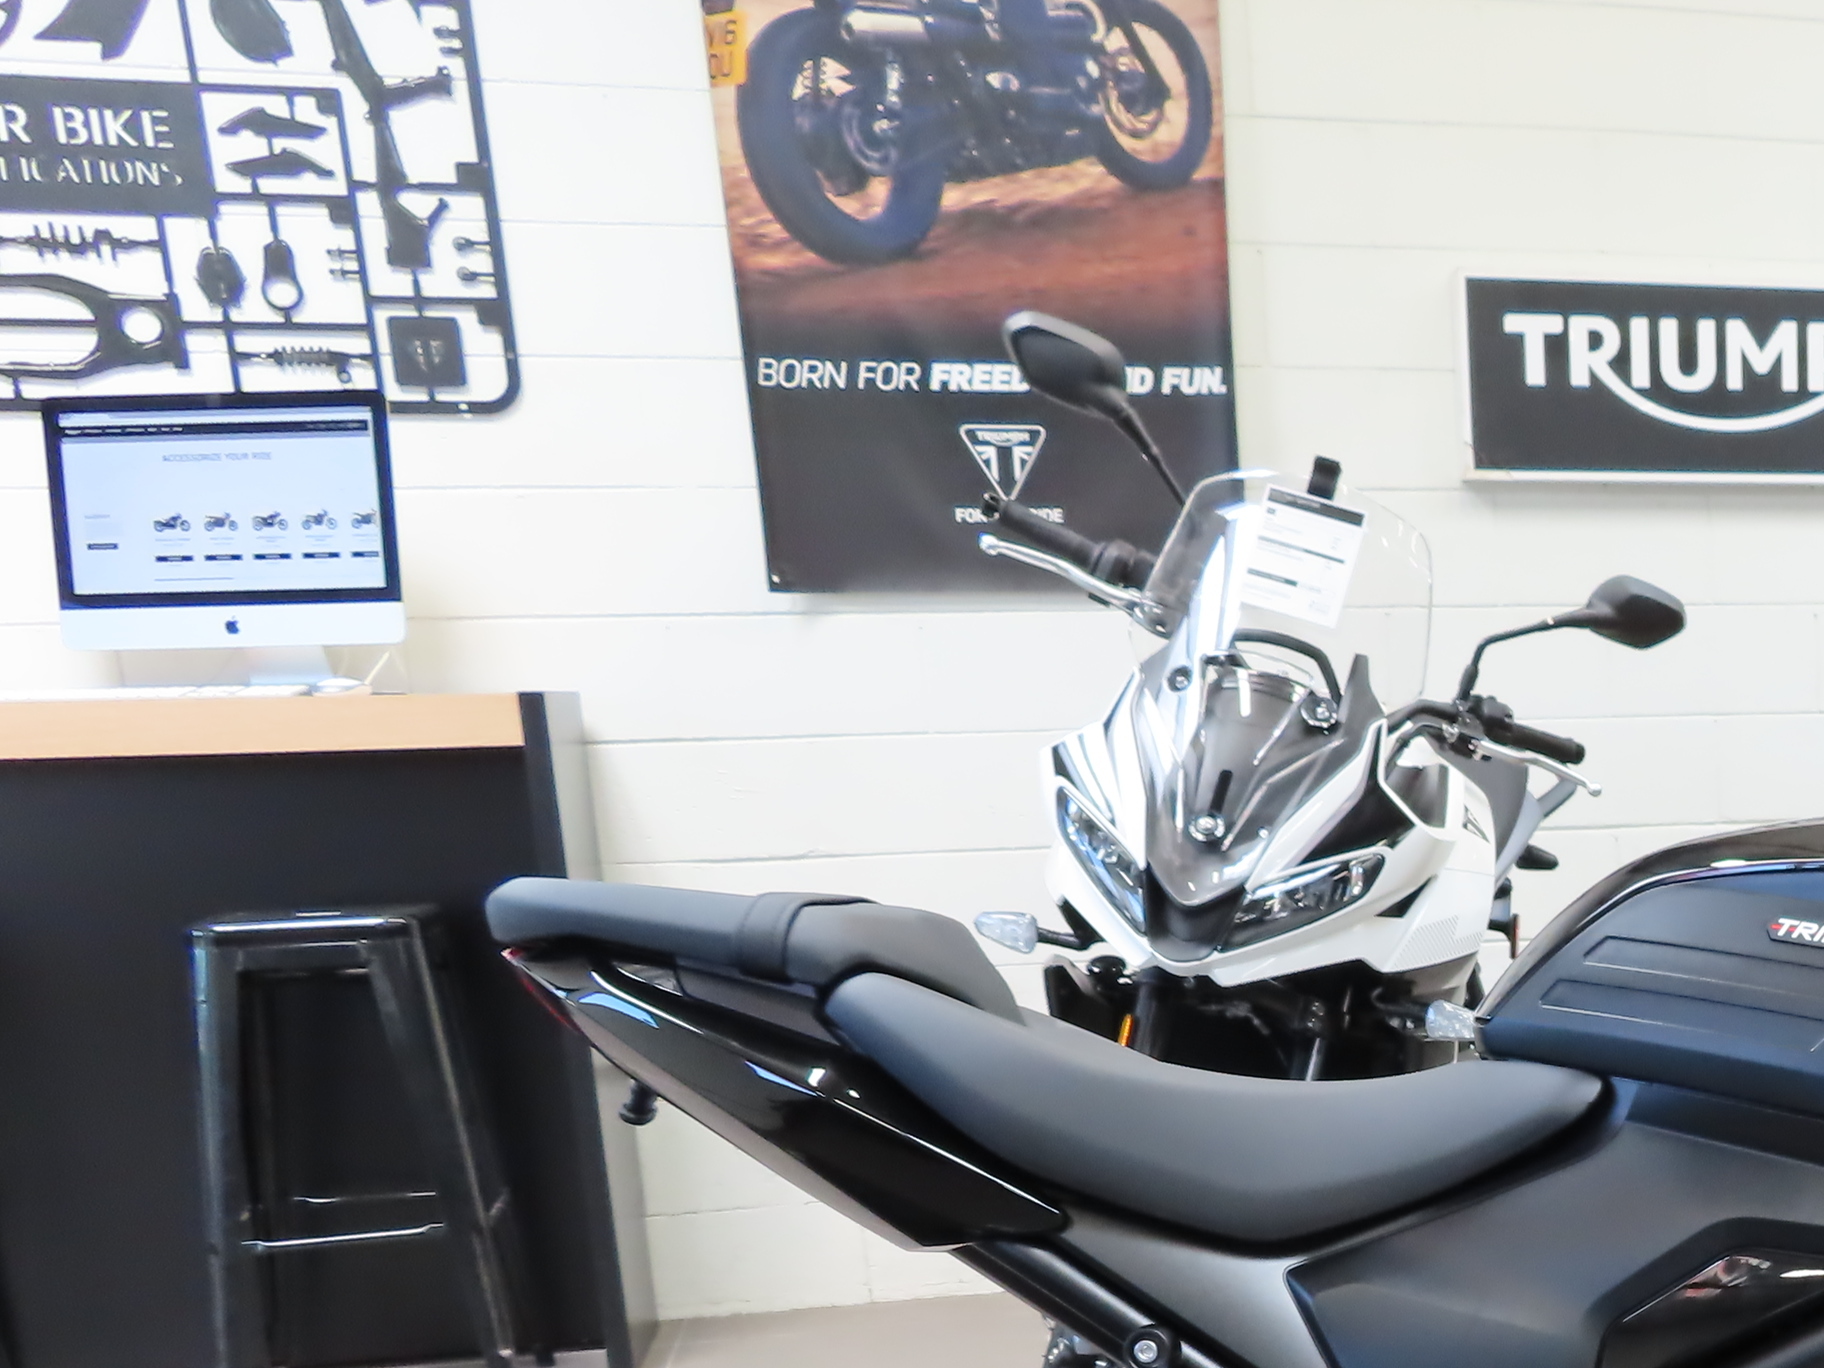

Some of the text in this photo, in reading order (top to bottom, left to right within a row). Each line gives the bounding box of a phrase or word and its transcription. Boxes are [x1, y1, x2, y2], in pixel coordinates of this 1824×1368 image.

[52, 105, 175, 149] BIKE
[758, 357, 847, 390] BORN
[857, 361, 921, 391] FOR
[1161, 366, 1228, 396] FUN.
